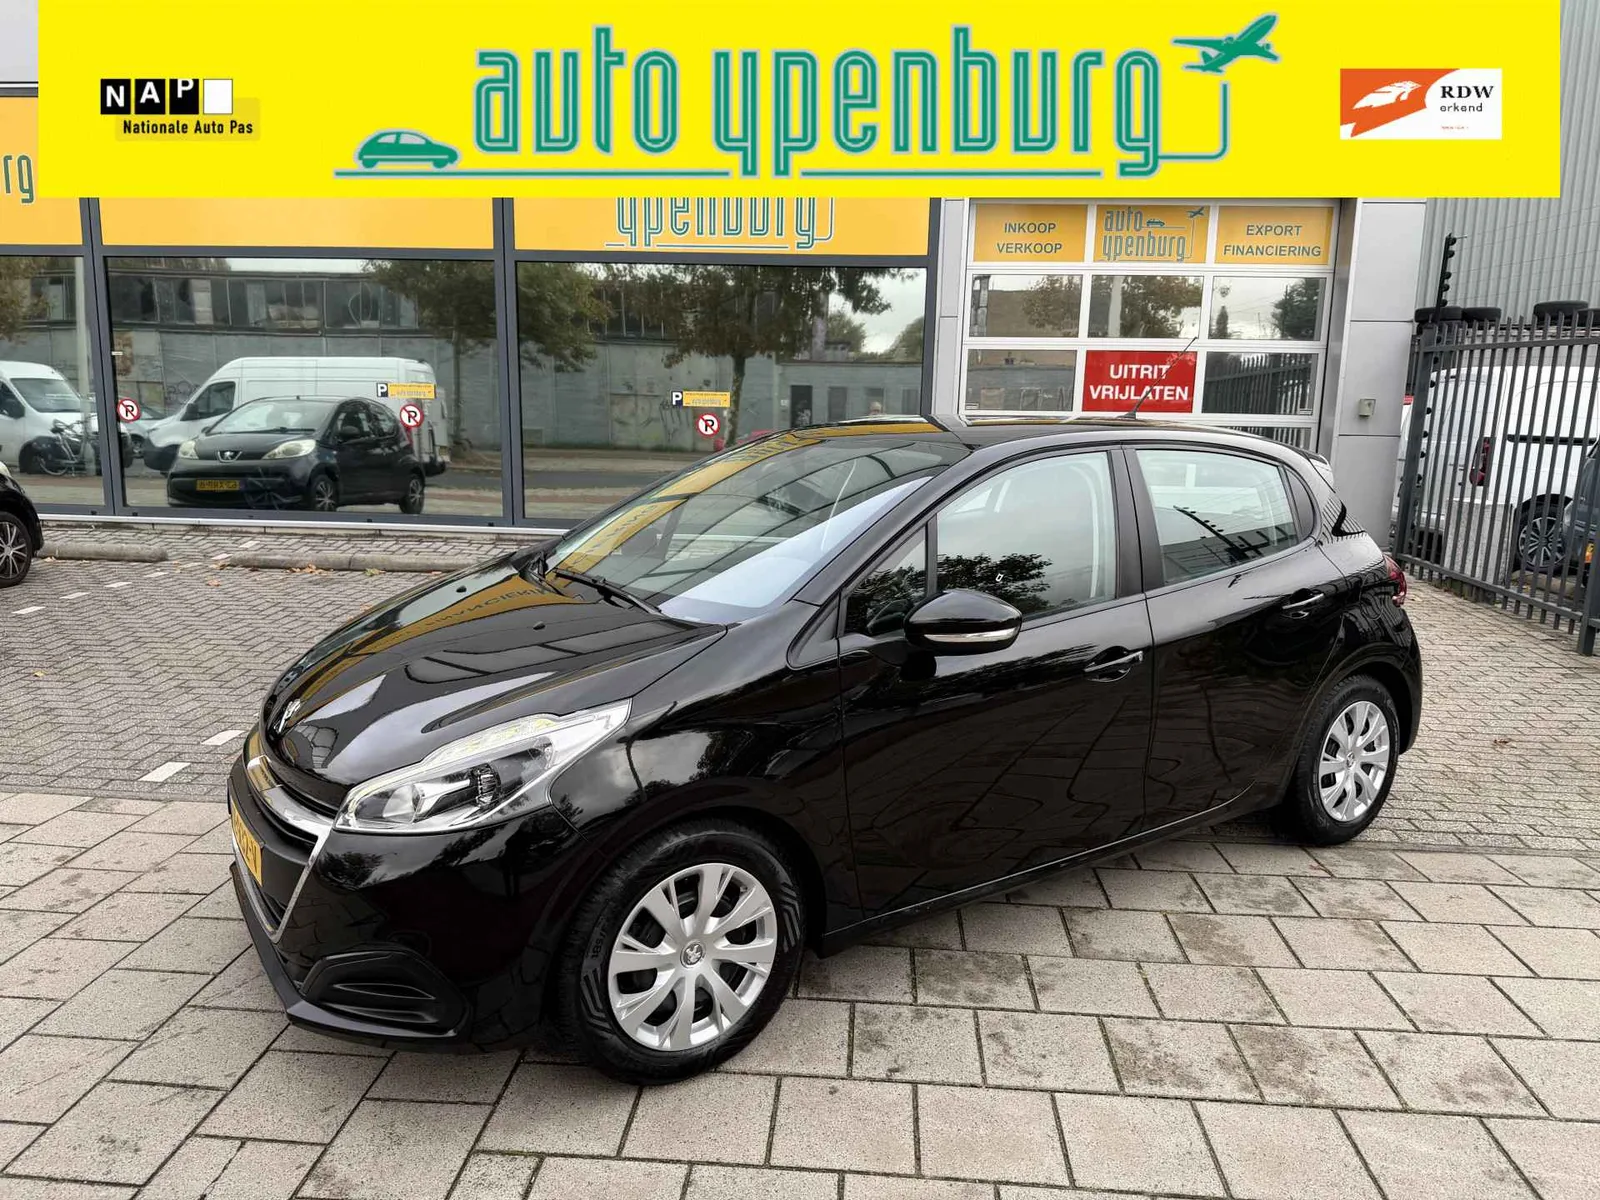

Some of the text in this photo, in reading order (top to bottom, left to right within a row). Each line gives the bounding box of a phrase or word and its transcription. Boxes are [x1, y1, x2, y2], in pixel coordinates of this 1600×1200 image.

[1104, 206, 1143, 232] auto
[1004, 222, 1057, 234] INKOOP
[1246, 224, 1302, 236] EXPORT
[997, 242, 1063, 254] VERKOOP
[1103, 231, 1186, 263] ypenburg
[1224, 244, 1321, 257] FINANCIERING
[1109, 364, 1170, 379] UITRIT
[377, 383, 388, 397] P
[1089, 385, 1189, 400] VRIJLATEN
[672, 391, 682, 405] P
